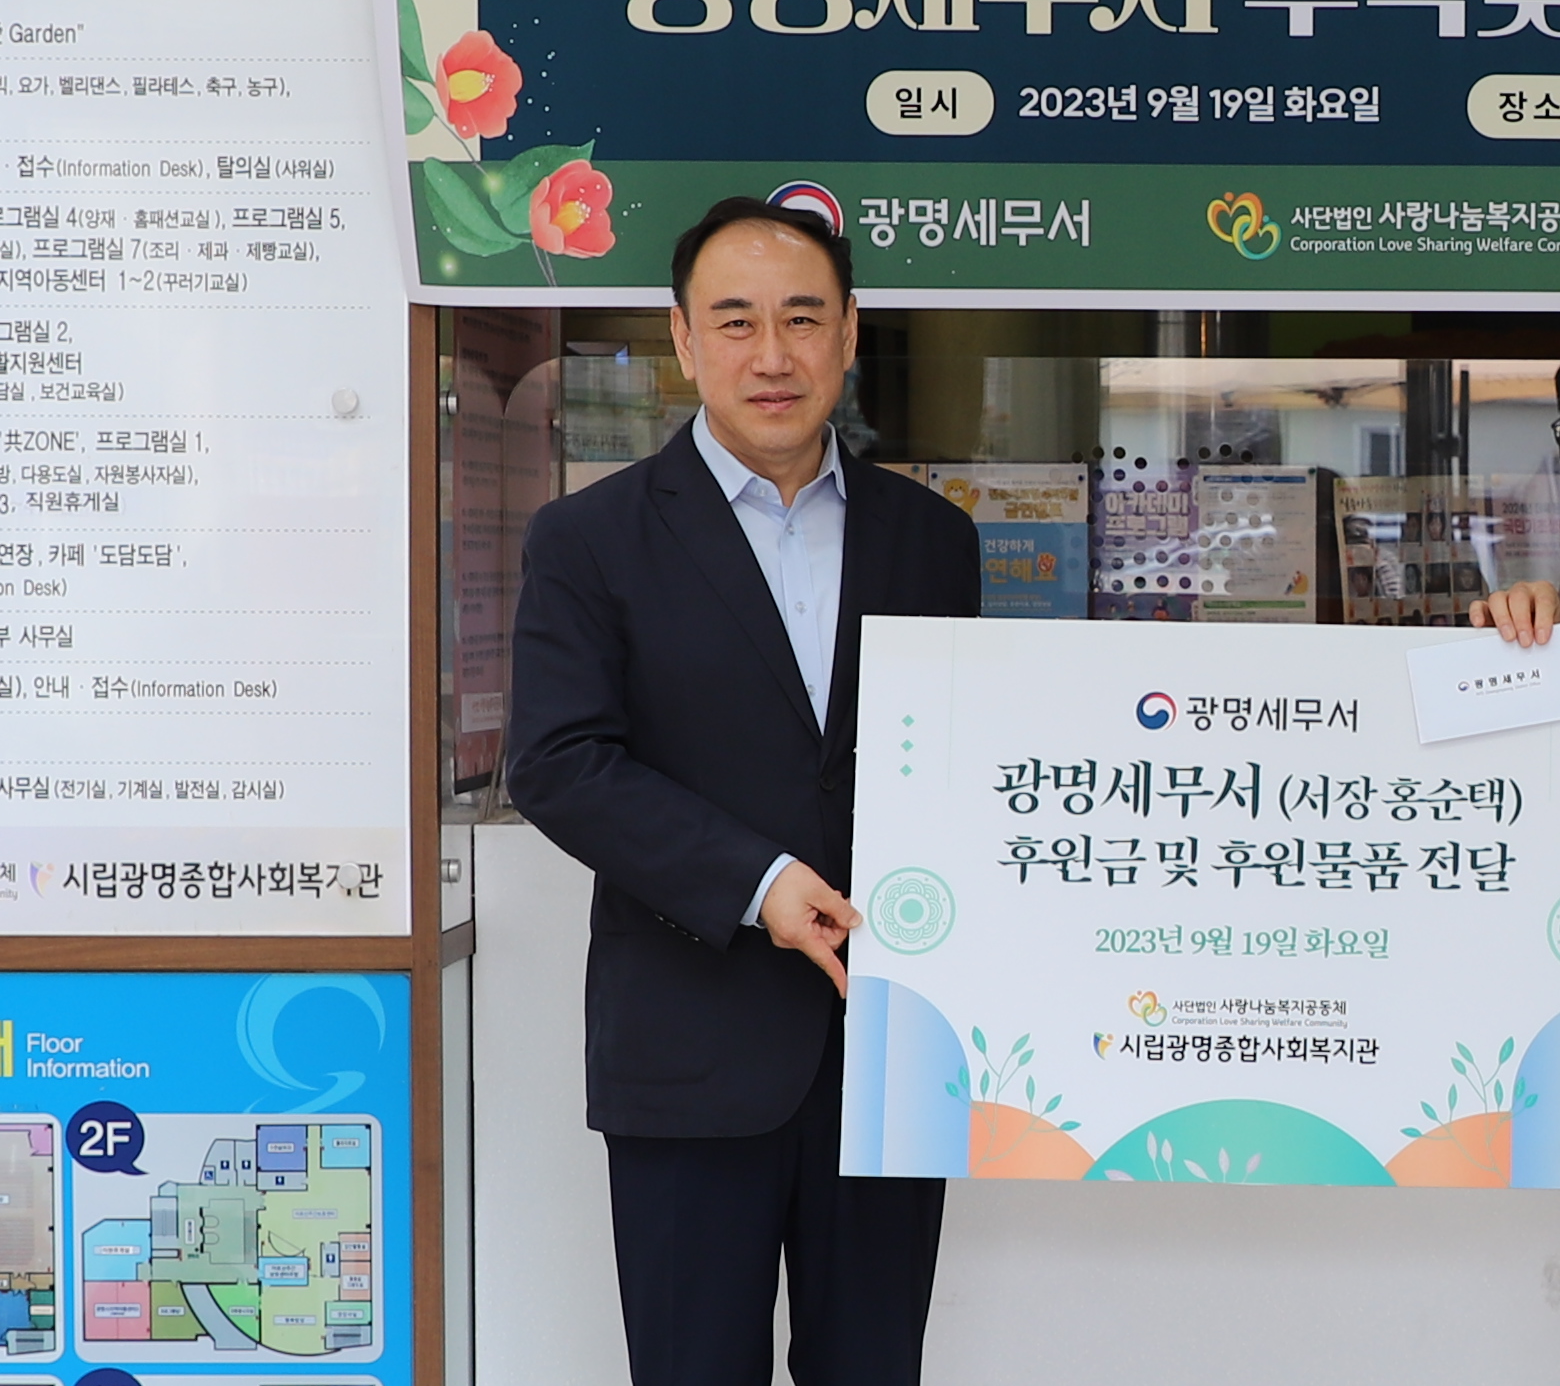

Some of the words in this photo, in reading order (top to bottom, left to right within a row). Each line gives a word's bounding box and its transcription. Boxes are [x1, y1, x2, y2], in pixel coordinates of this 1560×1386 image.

[8, 22, 84, 44] Garden"
[1019, 84, 1137, 121] 2023년
[1147, 85, 1200, 122] 9월
[1209, 85, 1275, 122] 19일
[1283, 86, 1380, 123] 화요일
[854, 192, 1095, 253] 광명세무서
[1290, 206, 1372, 231] 사단법인
[1290, 236, 1375, 254] Corporation
[1378, 237, 1413, 252] Love
[1416, 236, 1473, 256] Sharing
[1475, 236, 1534, 252] Welfare
[96, 429, 187, 454] 프로그램실
[984, 538, 1035, 554] 건강하게
[19, 625, 73, 649] 사무실
[1186, 696, 1358, 733] 광명세무서
[993, 757, 1261, 820] 광명세무서
[1279, 774, 1378, 822] (서장
[1384, 777, 1523, 826] 홍순택)
[998, 833, 1147, 887] 후원금
[1156, 836, 1198, 888] 및
[1212, 837, 1409, 892] 후원물품
[1419, 840, 1516, 892] 전달
[1095, 924, 1183, 954] 2023년
[1190, 925, 1232, 956] 9월
[1243, 926, 1297, 957] 19일
[1305, 927, 1389, 959] 화요일
[1173, 1000, 1217, 1014] 사단법인
[1220, 998, 1347, 1017] 사랑나눔복지공동체
[24, 1031, 85, 1057] Floor
[1120, 1034, 1380, 1065] 시립광명종합사회복지관
[24, 1056, 152, 1081] Information
[78, 1120, 132, 1157] 2F
